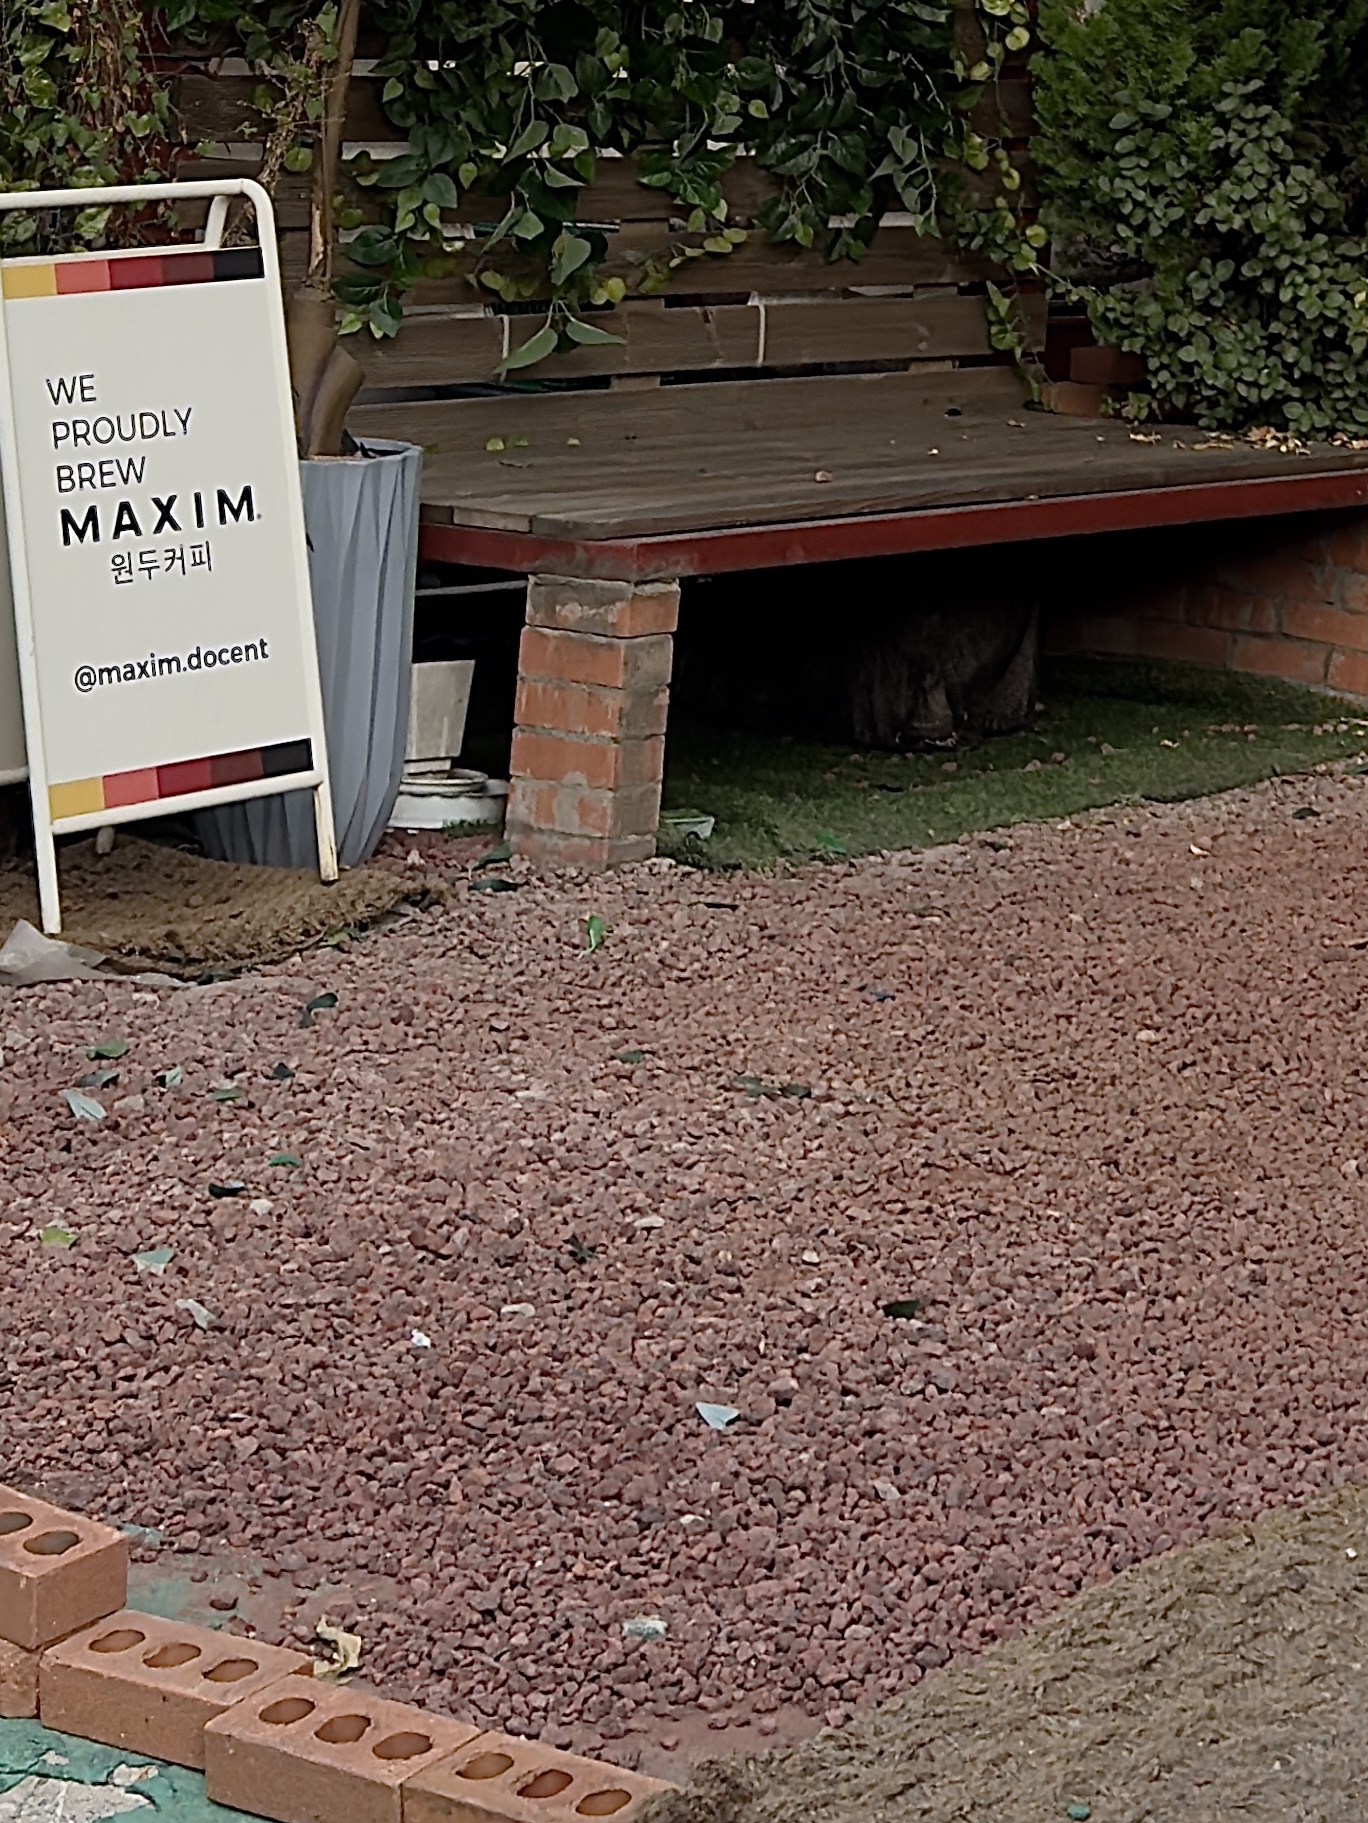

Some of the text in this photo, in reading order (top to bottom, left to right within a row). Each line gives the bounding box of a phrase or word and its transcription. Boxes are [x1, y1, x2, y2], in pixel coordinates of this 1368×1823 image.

[46, 374, 97, 406] WE
[51, 406, 193, 449] PROUDLY
[55, 456, 147, 494] BREW
[59, 485, 256, 547] MAXIM
[109, 542, 213, 586] 원두커피
[73, 638, 269, 693] @maxim.docent
